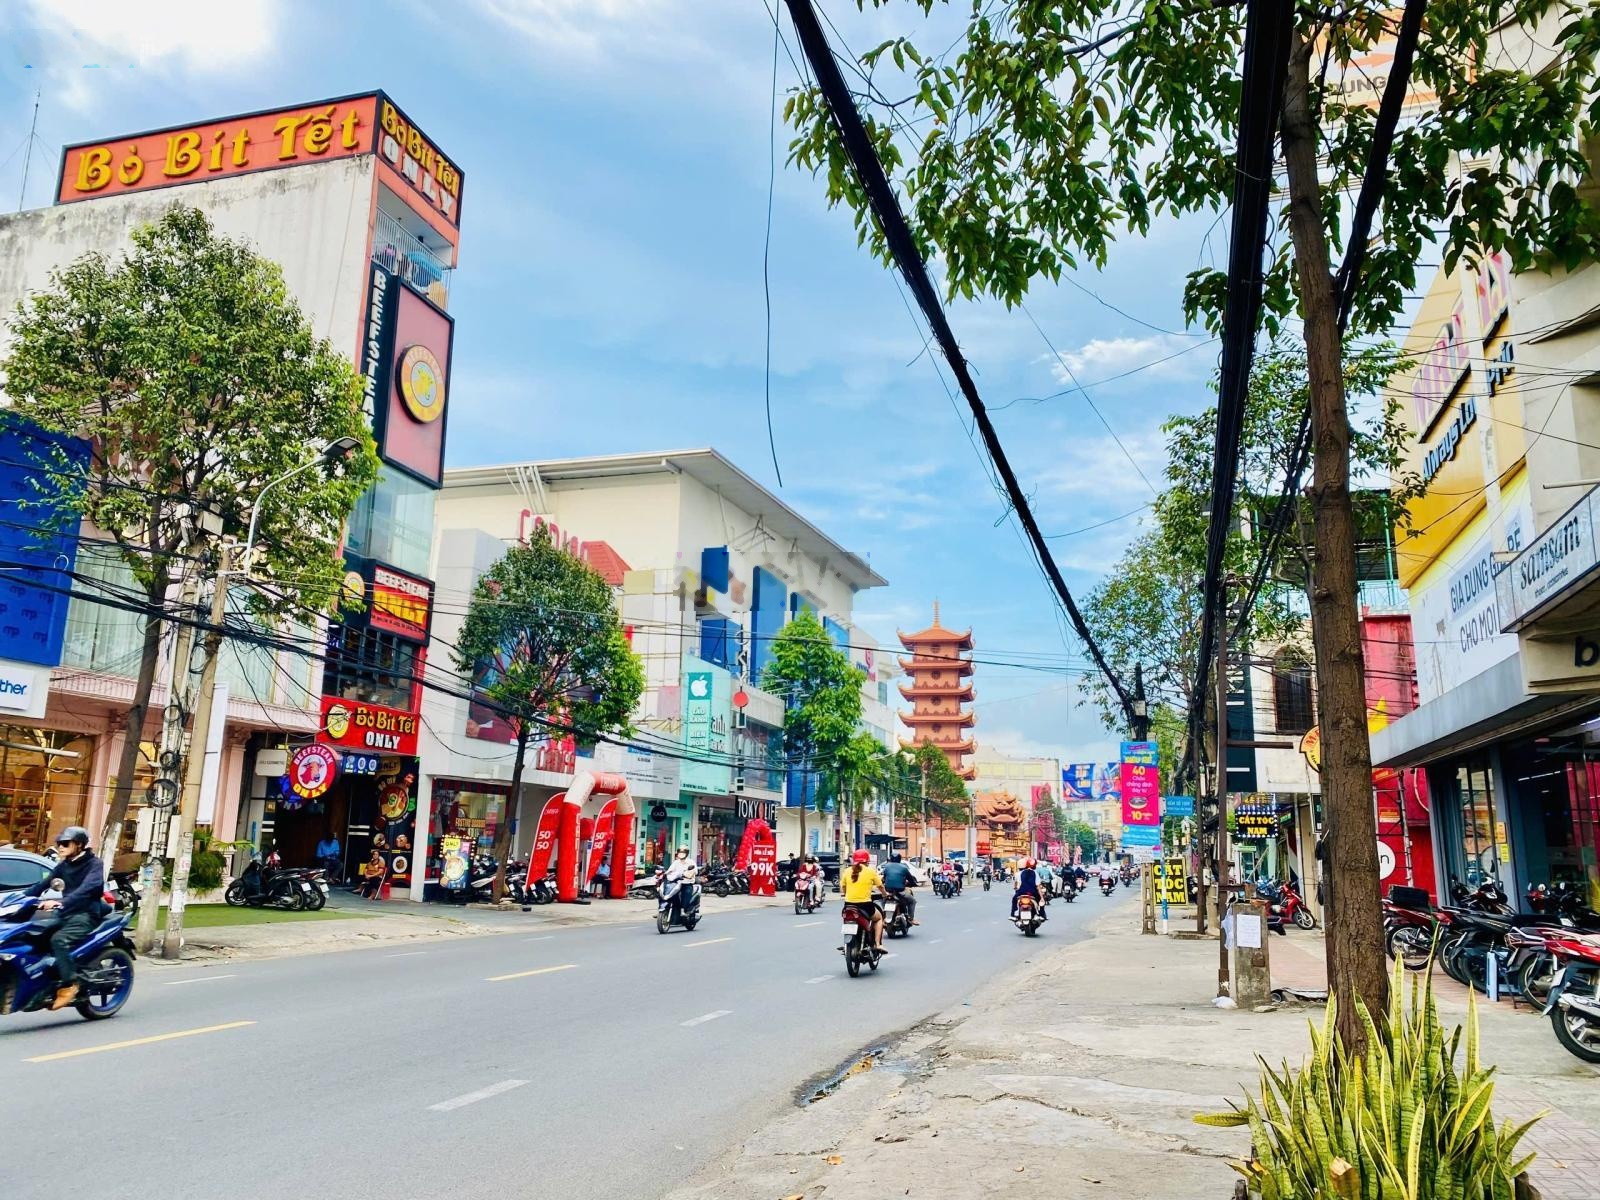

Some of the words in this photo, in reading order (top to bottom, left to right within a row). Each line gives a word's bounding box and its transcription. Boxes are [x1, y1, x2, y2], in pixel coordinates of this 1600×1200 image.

[381, 99, 408, 144] Bò
[73, 144, 145, 192] Bò
[162, 130, 251, 177] Bít
[273, 106, 360, 161] Tết
[382, 134, 454, 217] ONLY
[1521, 515, 1581, 590] samsam
[1450, 579, 1464, 613] GIA
[1464, 561, 1490, 603] DỤNG
[1460, 620, 1479, 654] CHO
[355, 706, 375, 728] Bò
[365, 731, 401, 750] ONLY
[293, 745, 334, 766] BEEFSTEAK
[1132, 765, 1146, 776] 40
[292, 782, 328, 799] ONLY
[1238, 814, 1256, 825] CẮT
[1246, 826, 1268, 835] NAM
[750, 861, 775, 876] 99K
[1153, 859, 1183, 876] CẮT
[1154, 876, 1184, 890] TÓC
[1156, 891, 1186, 904] NAM
